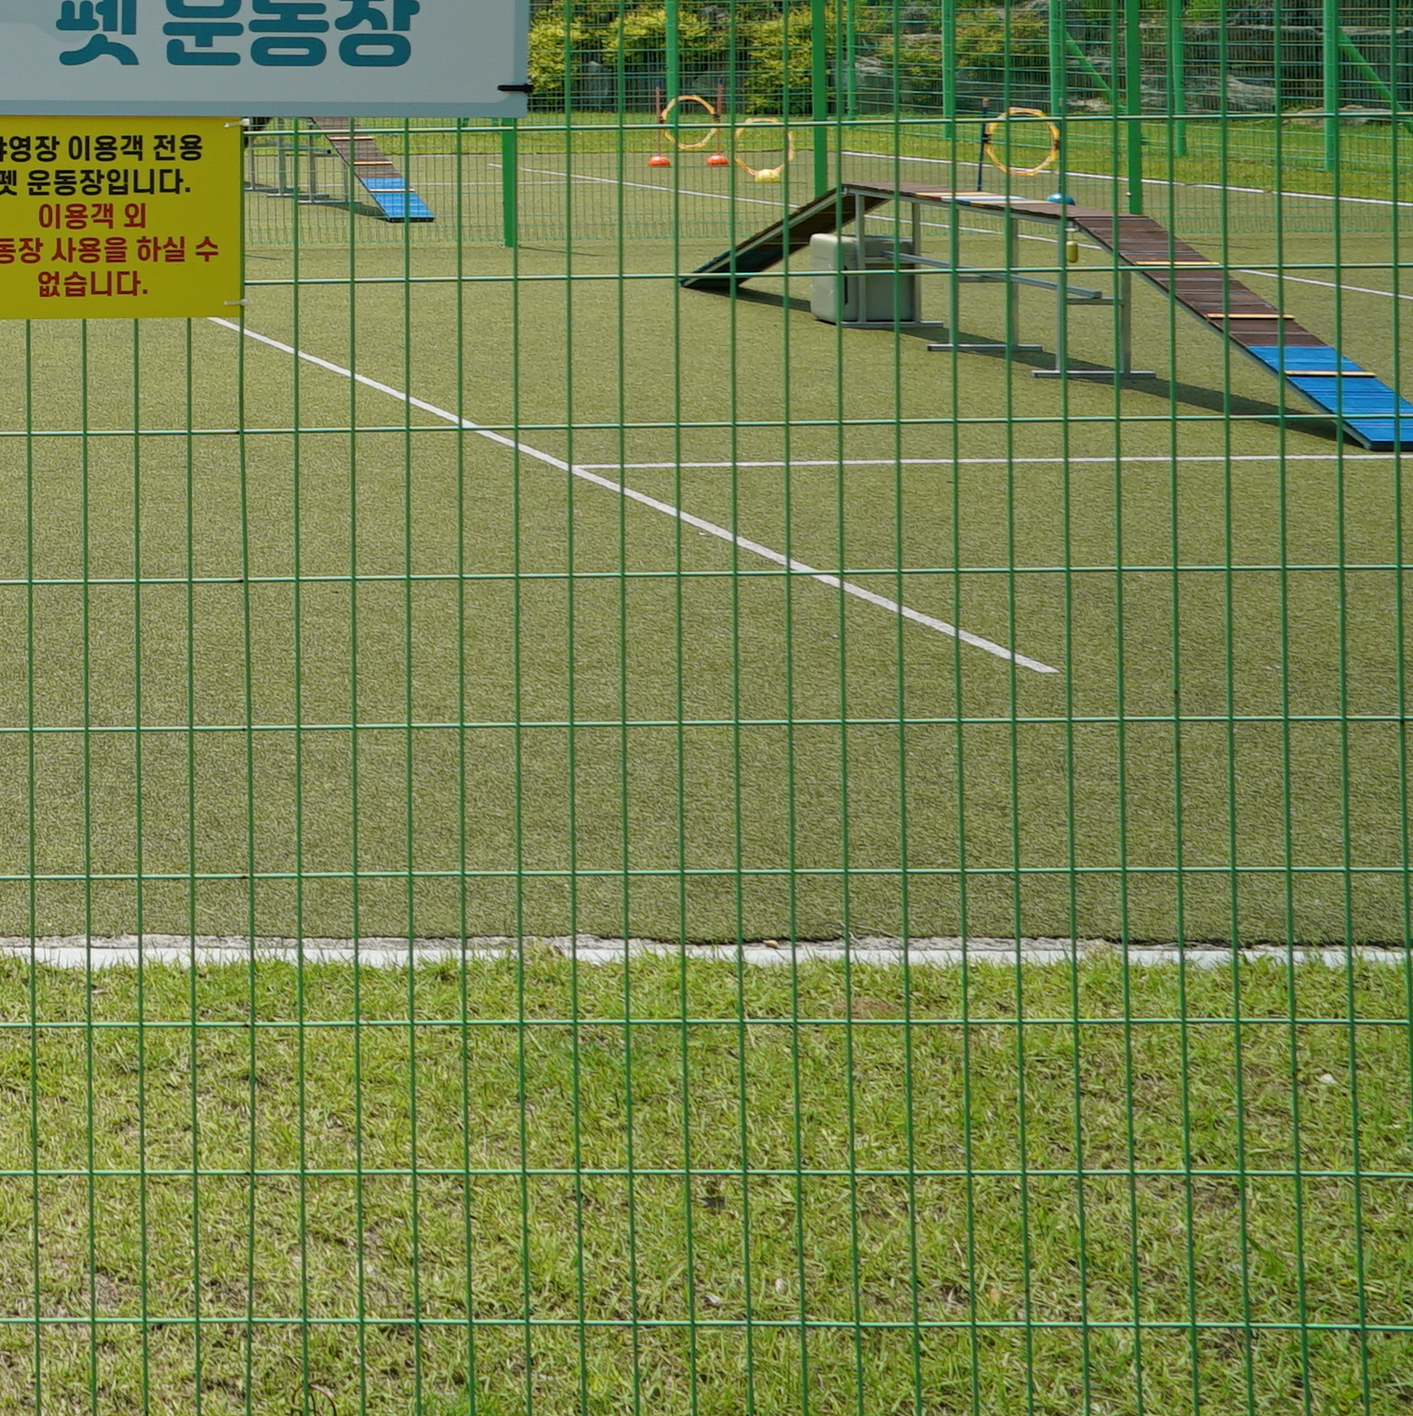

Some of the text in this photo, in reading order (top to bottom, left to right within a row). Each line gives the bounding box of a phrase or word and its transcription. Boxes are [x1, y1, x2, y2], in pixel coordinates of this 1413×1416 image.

[69, 135, 143, 161] 이용객
[154, 135, 202, 161] 전용
[27, 169, 190, 196] 운동장입니다.
[39, 203, 145, 229] 이용객 외
[52, 237, 127, 263] 사용을
[137, 236, 185, 262] 하실
[196, 236, 218, 262] 수
[38, 271, 147, 297] 없습니다.
